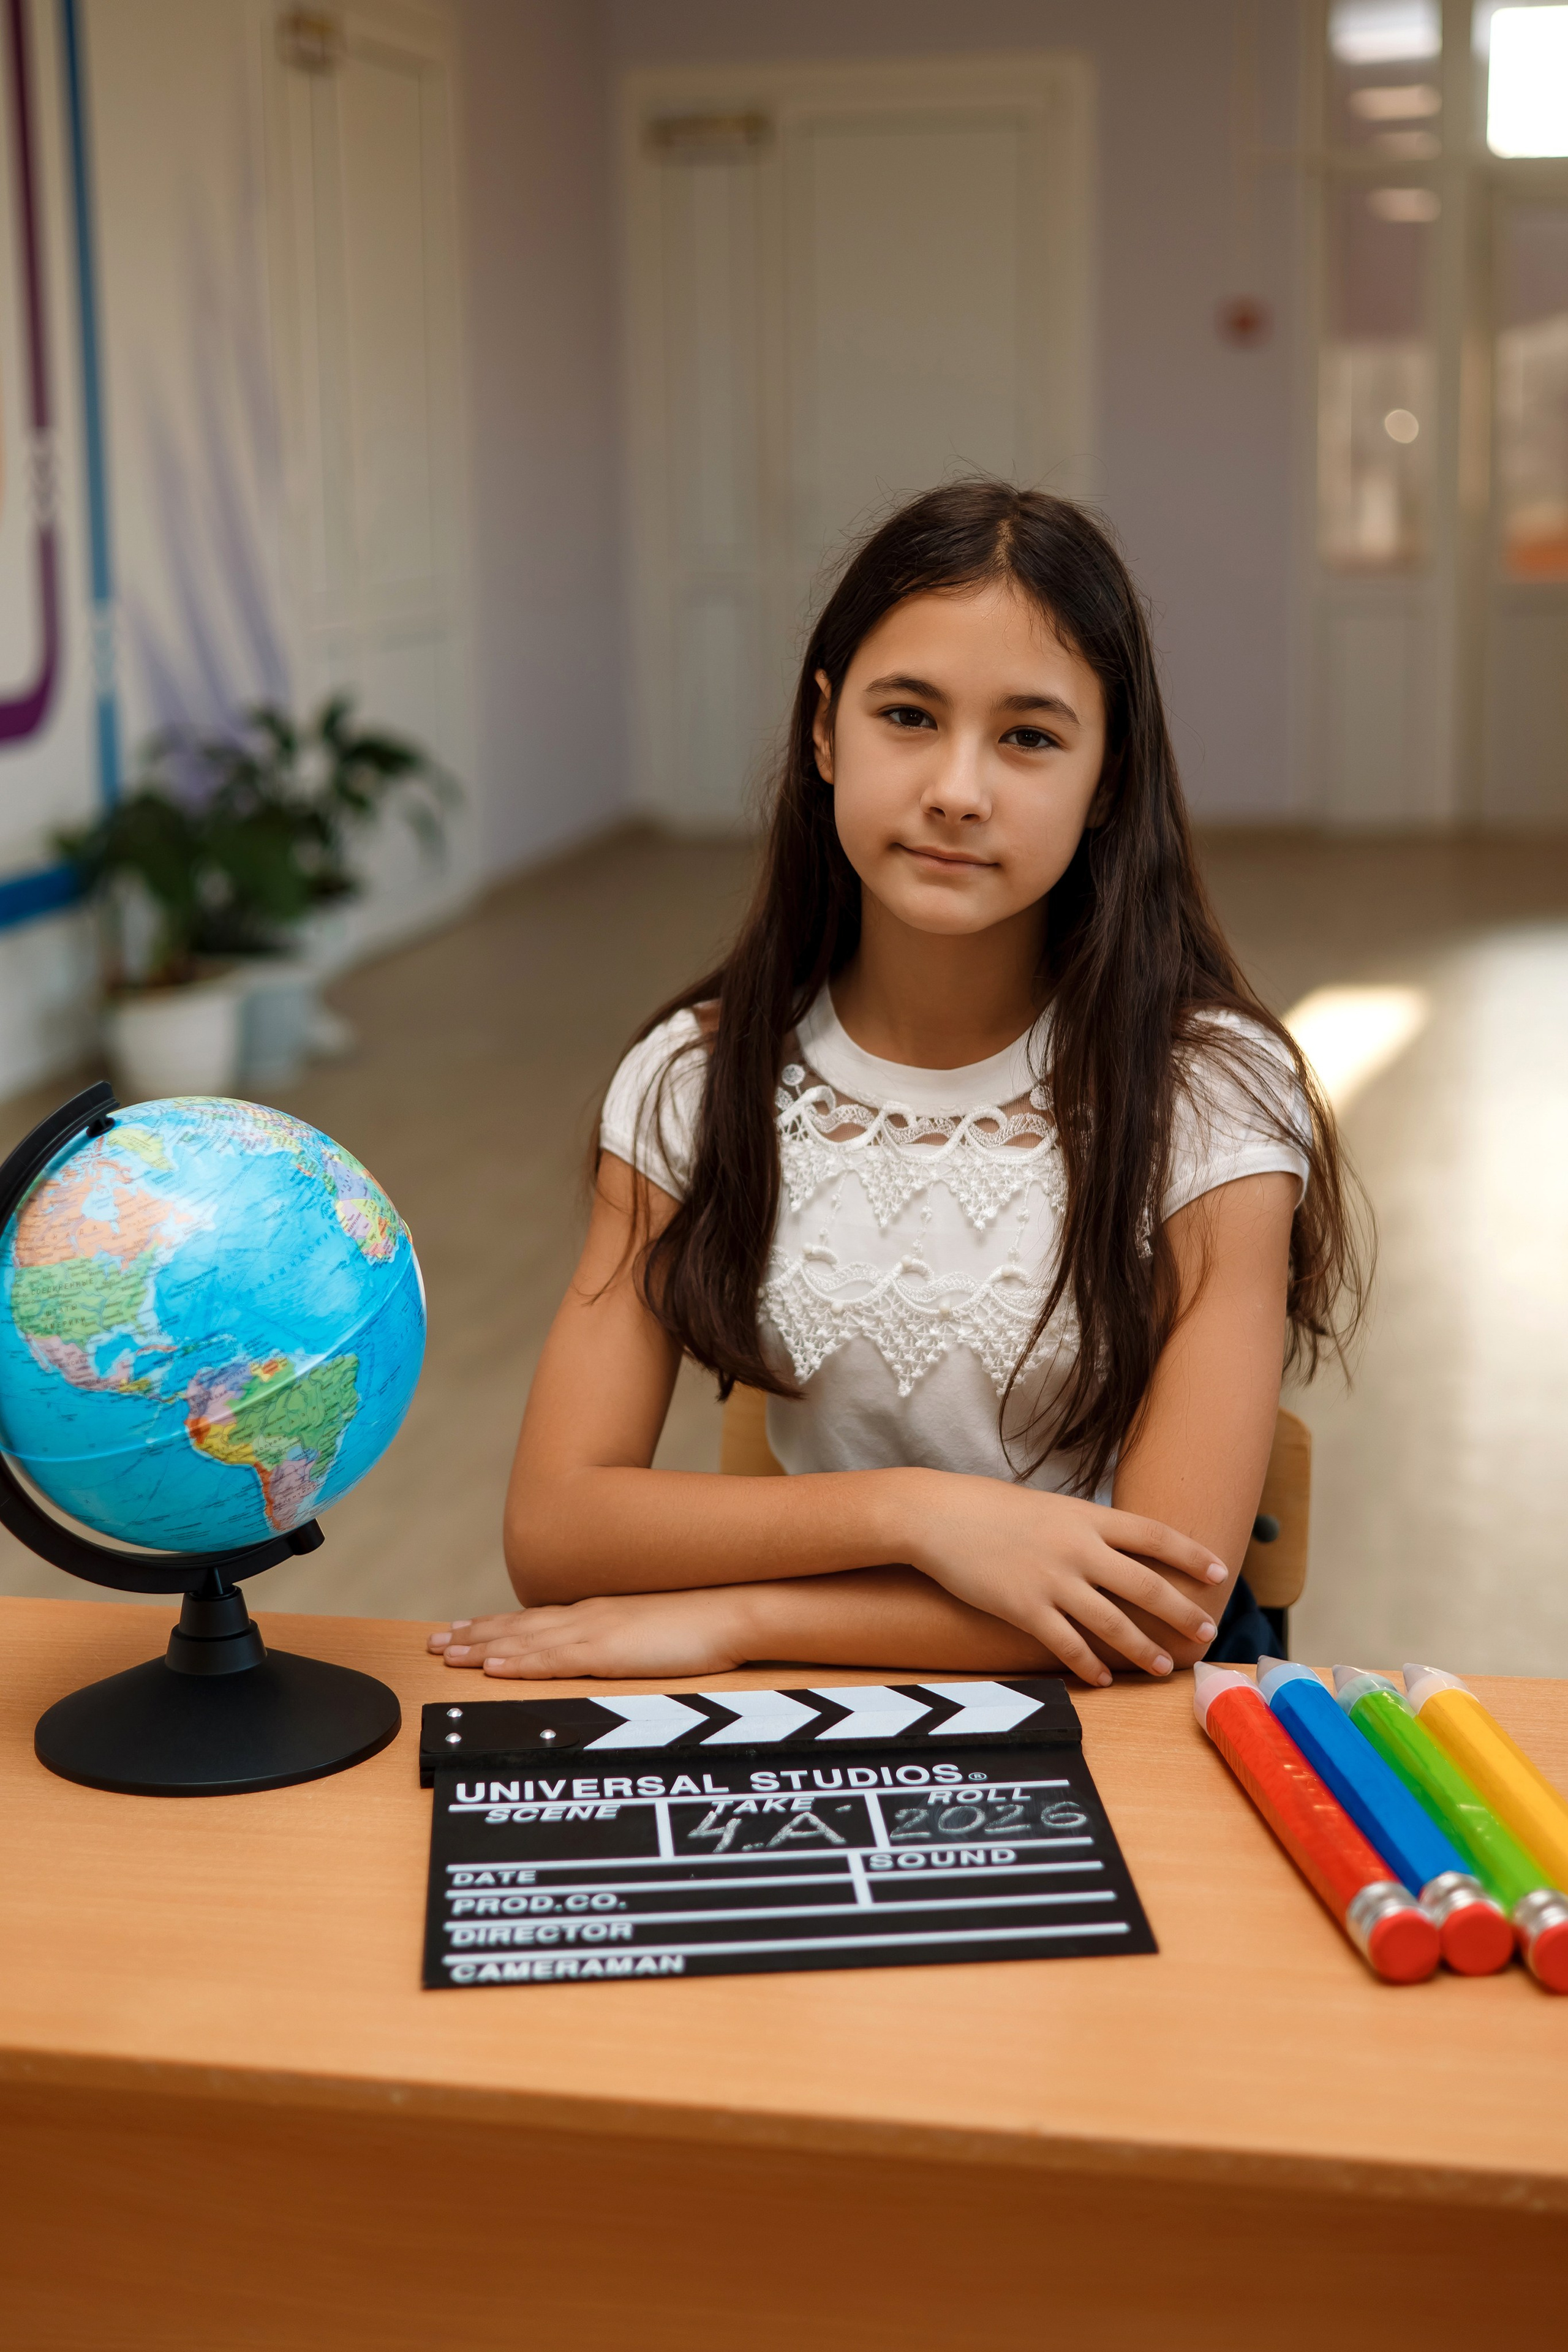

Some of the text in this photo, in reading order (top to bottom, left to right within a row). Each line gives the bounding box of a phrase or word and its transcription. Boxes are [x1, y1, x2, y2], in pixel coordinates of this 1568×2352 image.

[456, 1774, 729, 1803] UNIVERSAL
[927, 1787, 1031, 1804] ROLL
[485, 1804, 621, 1824] SCENE
[710, 1796, 815, 1816] TAKE
[889, 1801, 1087, 1839] 2026
[869, 1849, 1017, 1870] SOUND
[451, 1870, 537, 1887] DATE
[451, 1923, 633, 1947] DIRECTOR
[450, 1955, 685, 1983] CAMERAMAN
